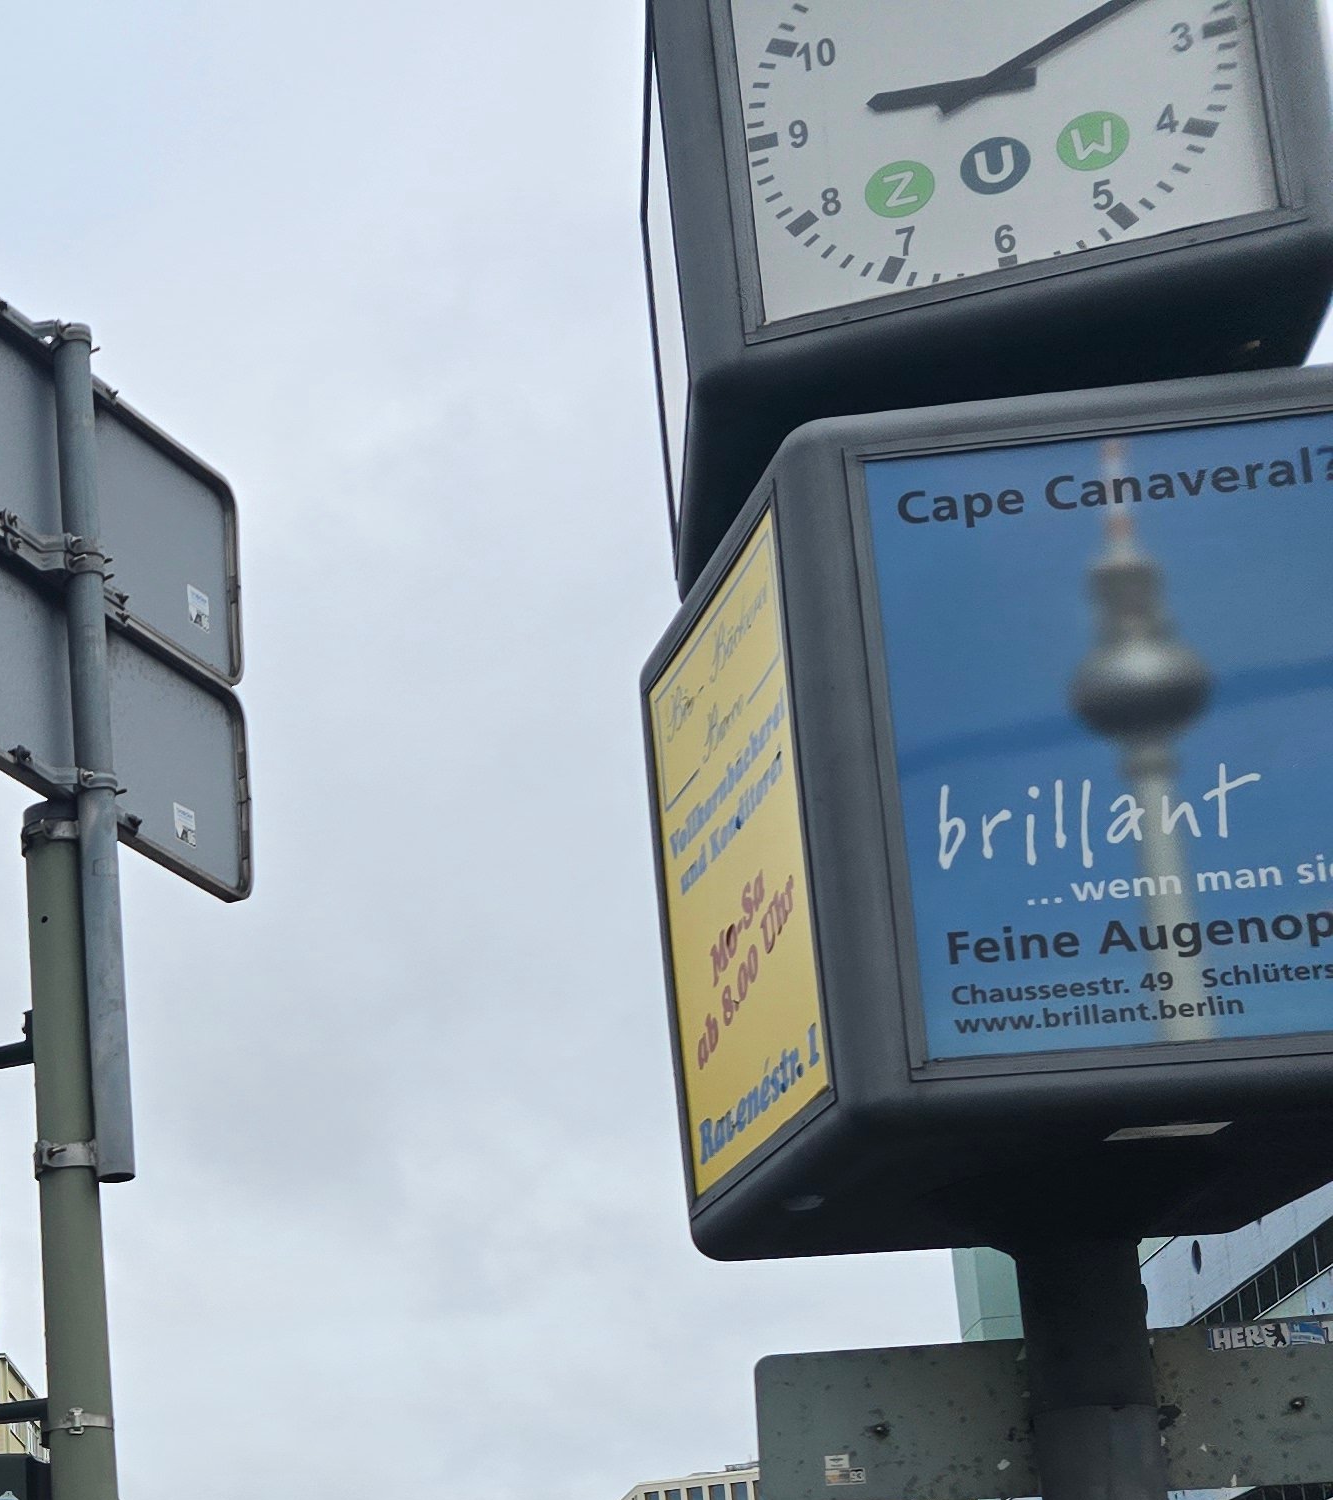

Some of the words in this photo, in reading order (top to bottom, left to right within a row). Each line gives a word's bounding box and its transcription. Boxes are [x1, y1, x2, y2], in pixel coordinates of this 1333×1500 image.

[796, 38, 836, 72] 10
[1170, 22, 1194, 52] 3
[789, 119, 808, 148] 9
[1156, 103, 1179, 133] 4
[883, 170, 918, 208] Z
[974, 144, 1014, 184] U
[1070, 119, 1112, 161] W
[821, 187, 841, 216] 8
[1092, 179, 1114, 210] 5
[895, 226, 915, 256] 7
[994, 224, 1016, 253] 6
[897, 488, 1024, 528] Cape
[1044, 445, 1333, 511] Canaveral?
[680, 843, 707, 896] und
[709, 744, 782, 862] Konditorei
[938, 763, 1261, 870] brillant
[1196, 865, 1282, 893] man
[709, 869, 765, 988] Mo-Sa
[946, 926, 1081, 966] Feine
[1099, 911, 1333, 958] Augenop
[697, 1013, 719, 1070] ab
[722, 944, 758, 1027] 8.00
[760, 874, 794, 954] Uhr
[951, 976, 1130, 1006] Chausseestr.
[1140, 971, 1174, 992] 49
[1202, 963, 1333, 989] Schlüters
[954, 995, 1245, 1034] www.brillant.berlin
[807, 1022, 820, 1068] 1
